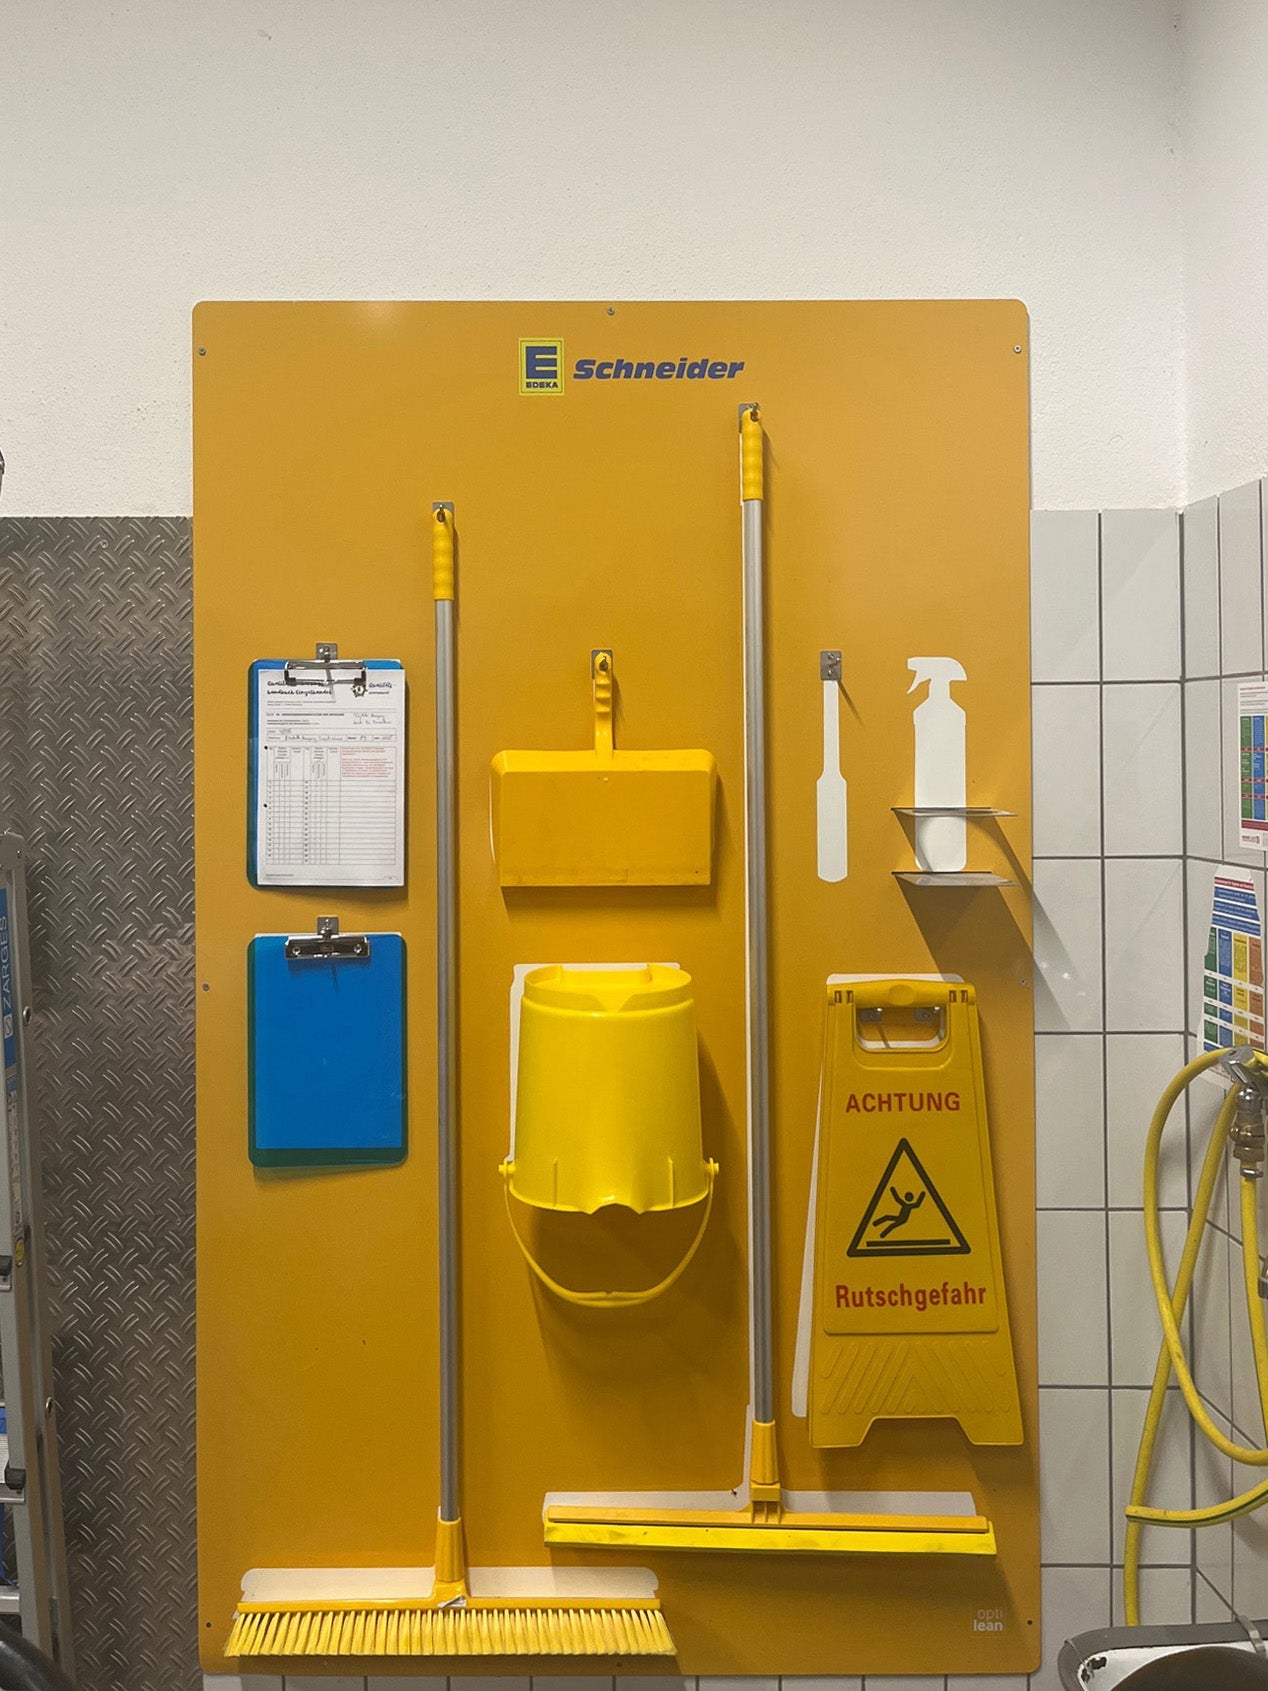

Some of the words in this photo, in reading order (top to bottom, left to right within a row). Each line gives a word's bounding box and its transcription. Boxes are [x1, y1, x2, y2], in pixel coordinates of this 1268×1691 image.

[573, 357, 745, 380] Schneider
[0, 915, 12, 1009] ZARGES
[845, 1092, 961, 1113] ACHTUNG
[835, 1282, 987, 1312] Rutschgefahr
[973, 1620, 1004, 1632] lean
